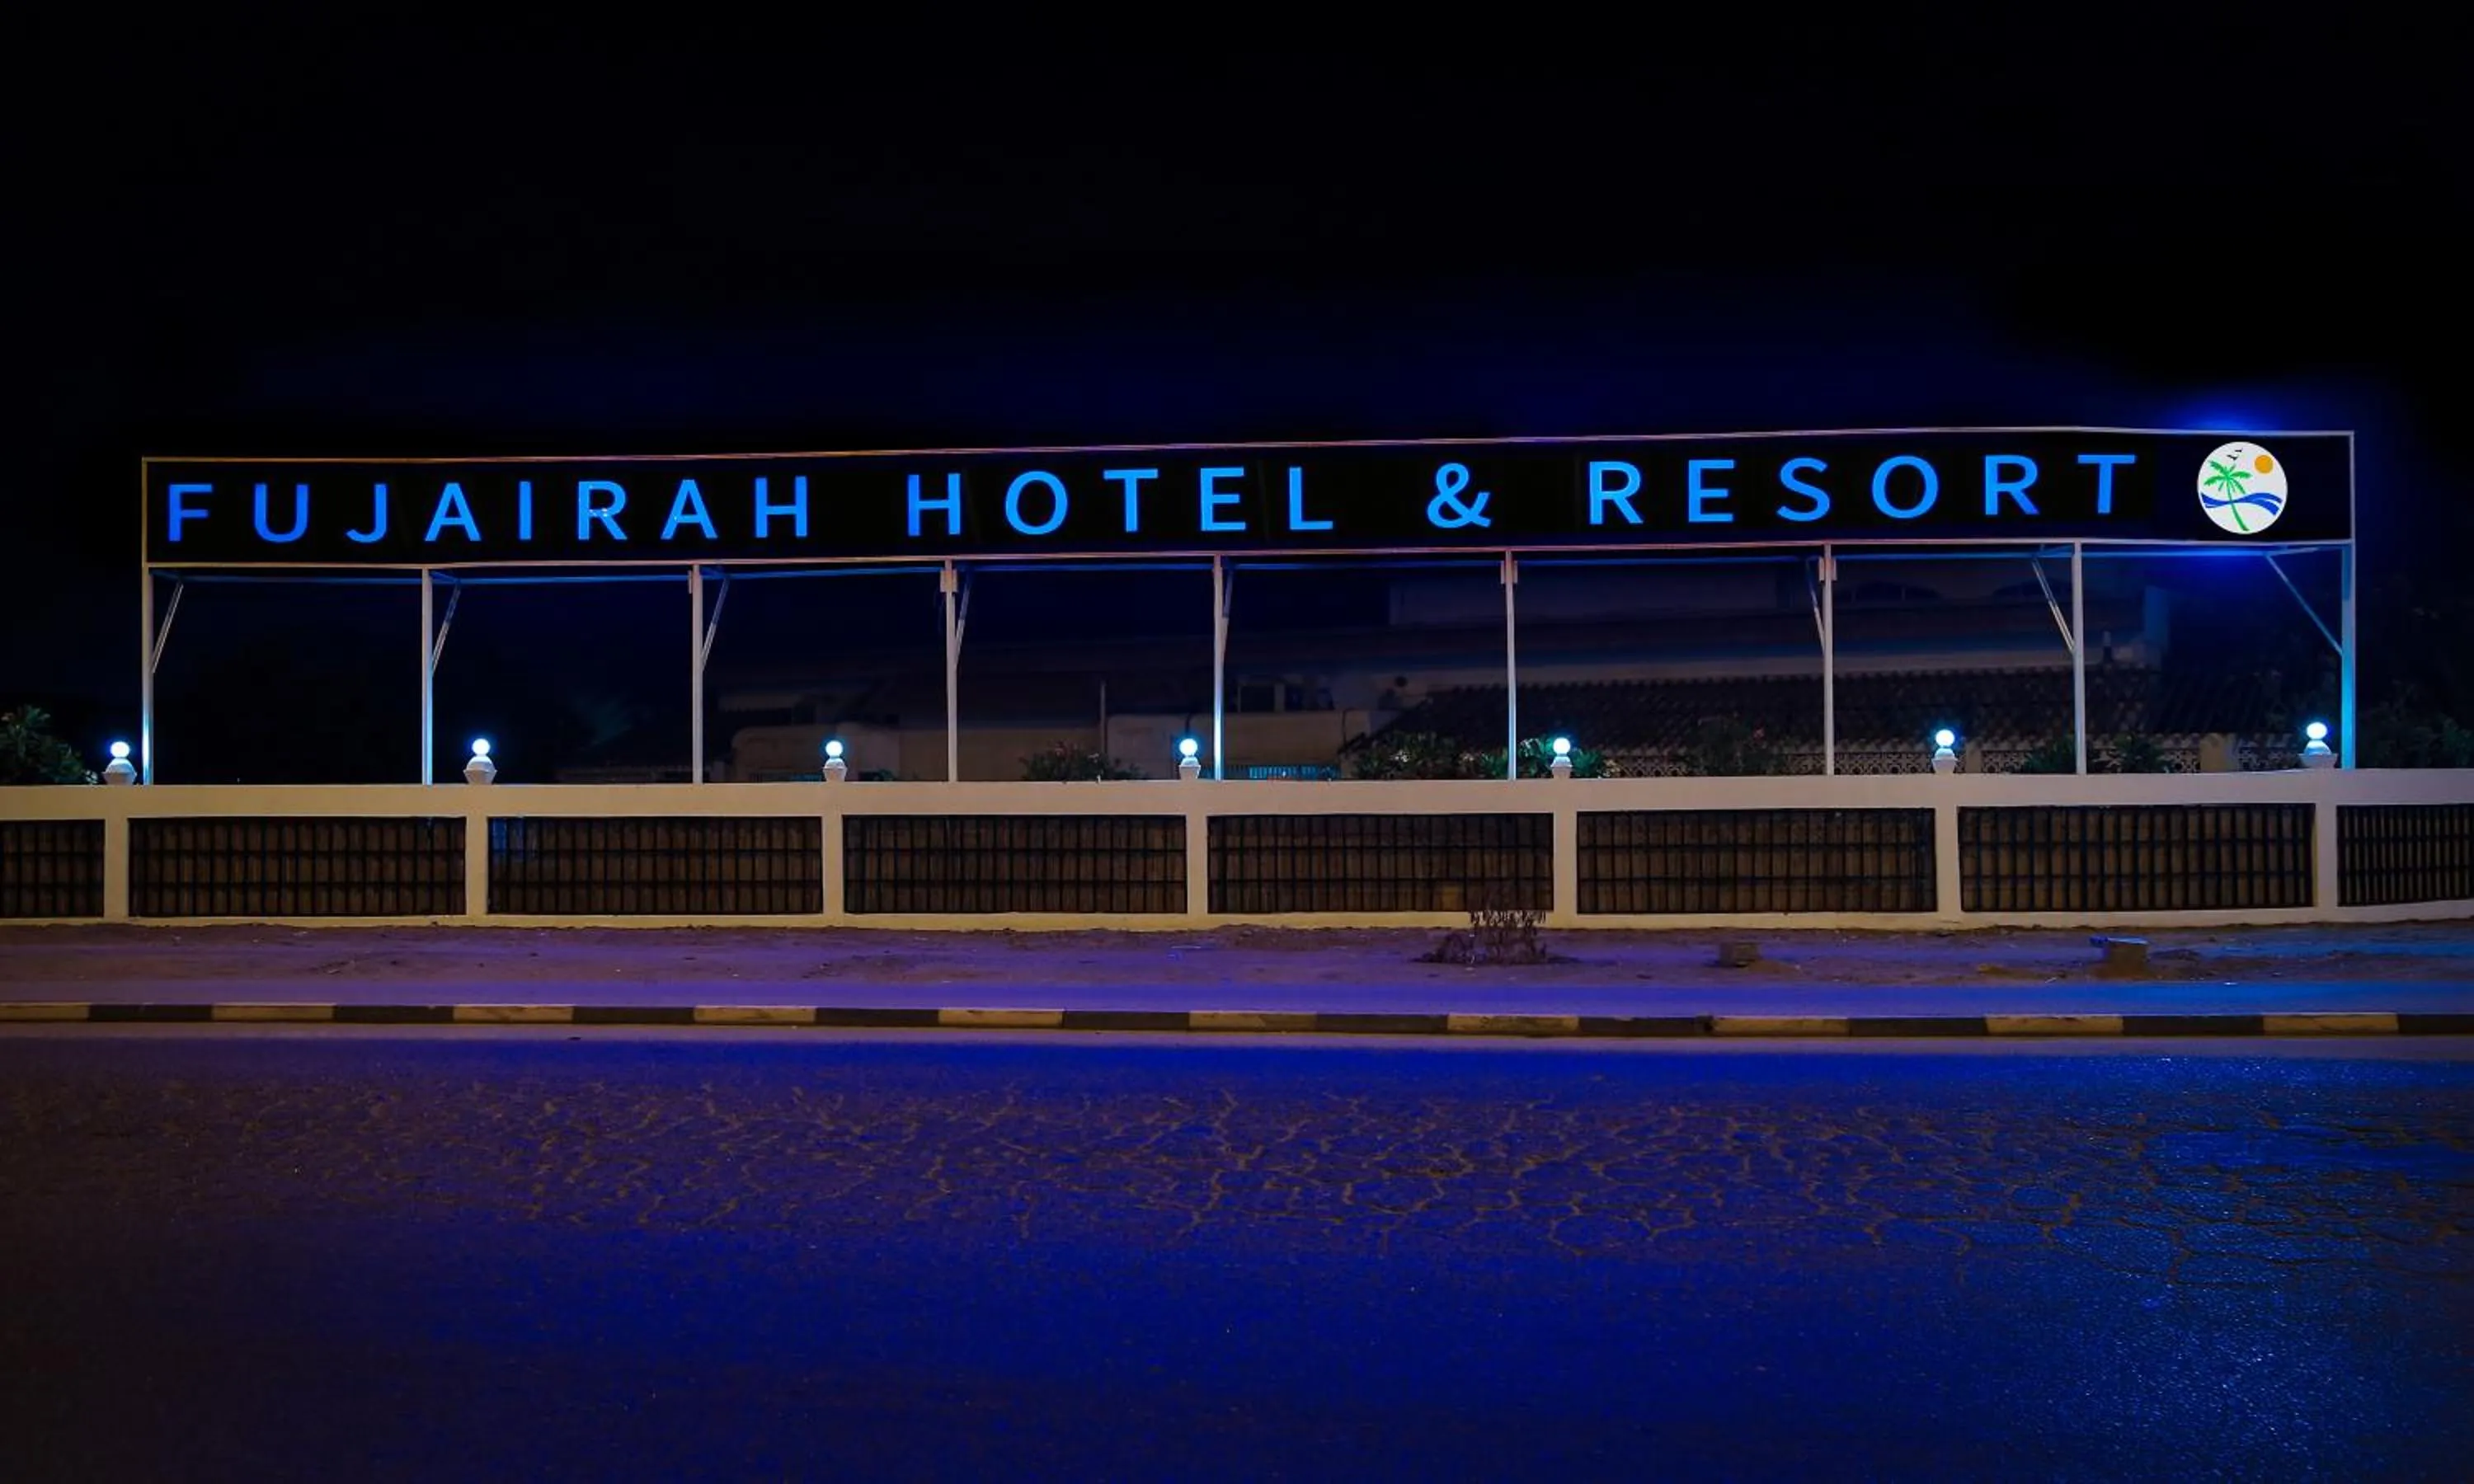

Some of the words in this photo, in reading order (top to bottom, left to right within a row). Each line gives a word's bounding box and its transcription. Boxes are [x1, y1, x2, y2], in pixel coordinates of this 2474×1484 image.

[168, 476, 809, 542] FUJAIRAH
[907, 467, 1334, 536] HOTEL
[1426, 462, 1492, 528] &
[1587, 454, 2137, 525] RESORT
